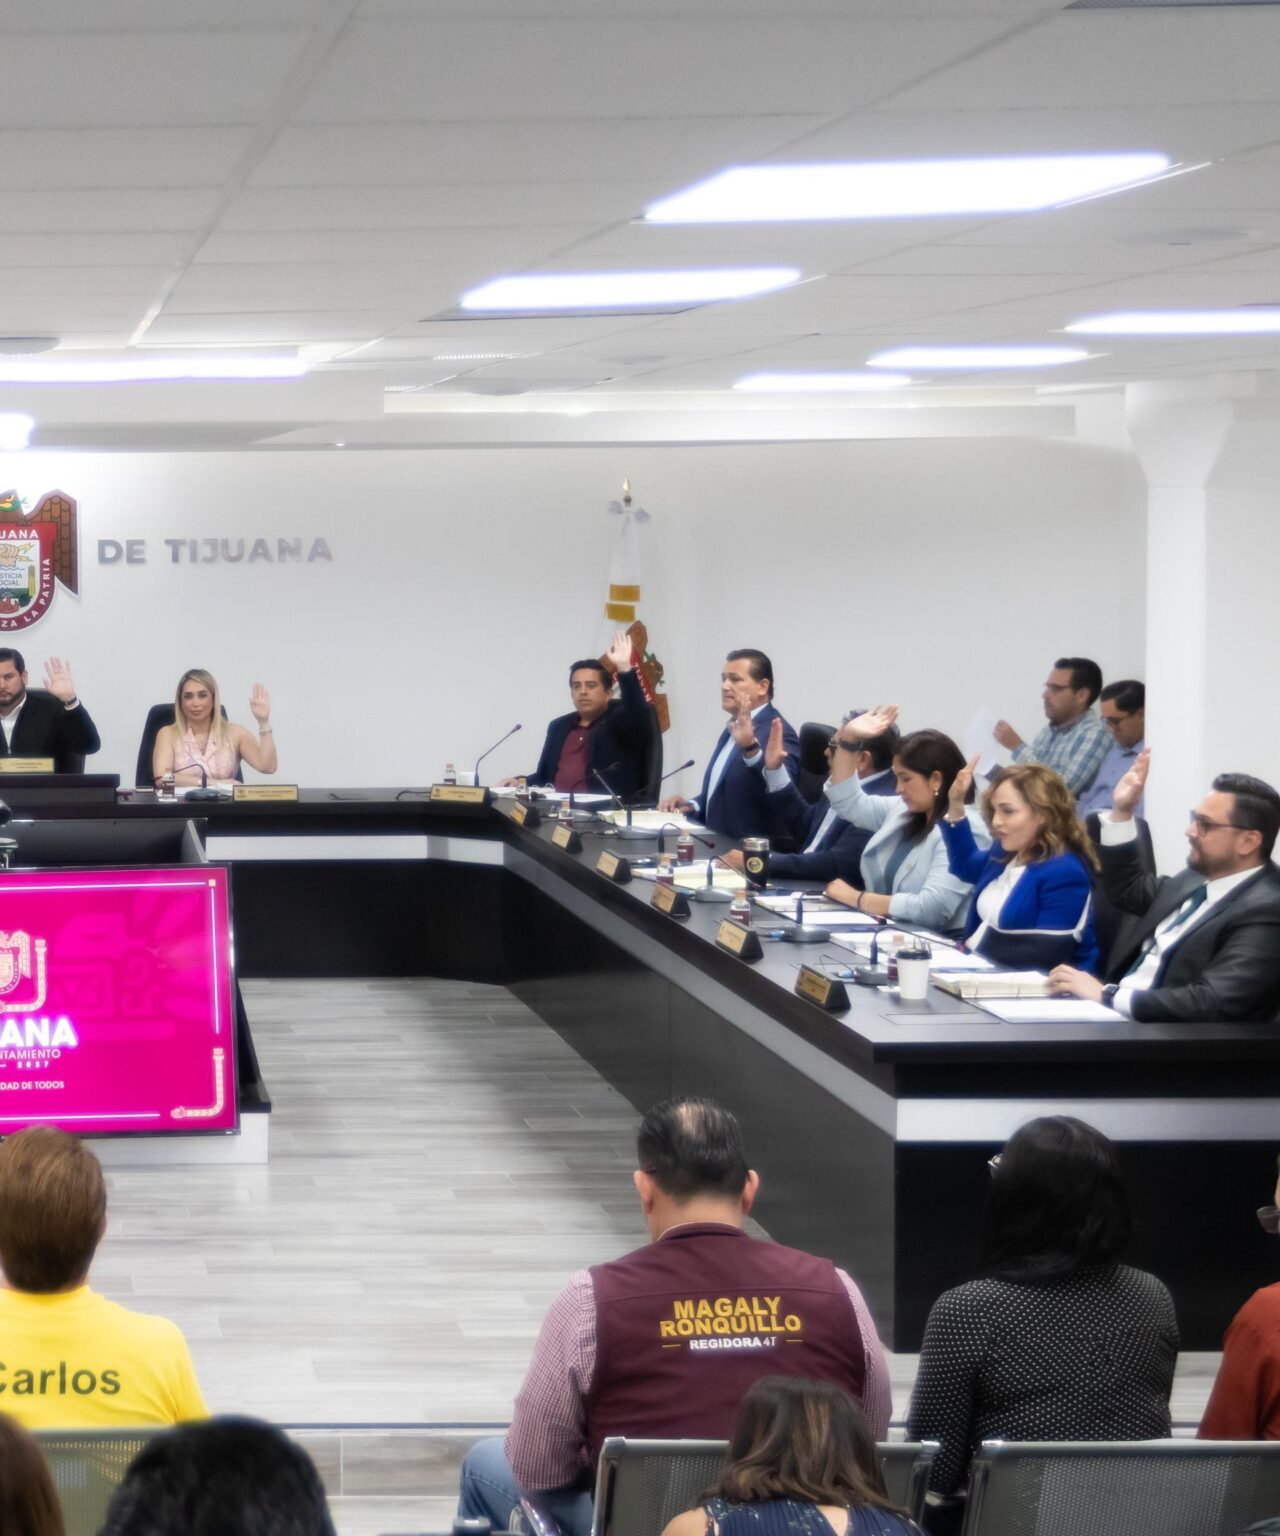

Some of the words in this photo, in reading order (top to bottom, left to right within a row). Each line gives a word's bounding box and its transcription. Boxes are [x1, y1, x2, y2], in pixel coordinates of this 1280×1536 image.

[97, 539, 146, 565] DE
[164, 537, 333, 564] TIJUANA
[24, 611, 40, 623] LA
[39, 558, 51, 606] PATRIA
[17, 1061, 50, 1069] 2027
[21, 1081, 32, 1090] DE
[35, 1081, 65, 1090] TODOS
[673, 1296, 781, 1320] MAGALY
[659, 1314, 802, 1337] RONQUILLO
[689, 1337, 762, 1350] REGIDORA
[763, 1337, 777, 1347] 4T
